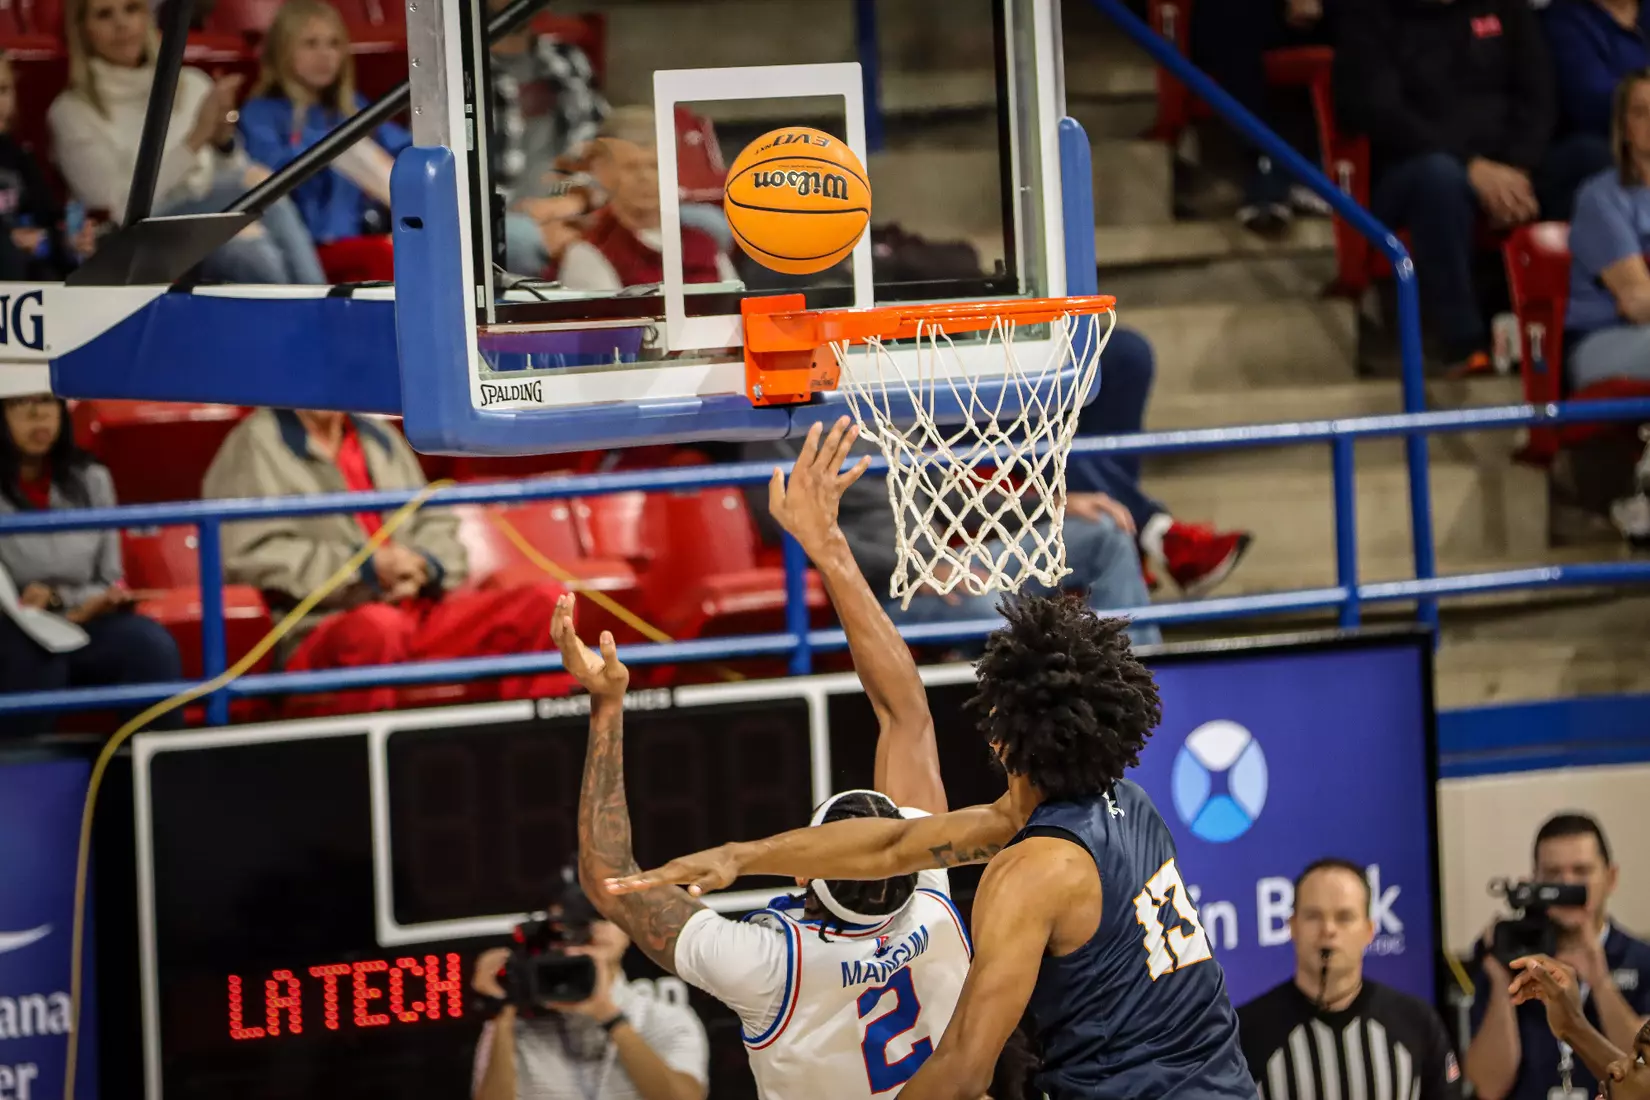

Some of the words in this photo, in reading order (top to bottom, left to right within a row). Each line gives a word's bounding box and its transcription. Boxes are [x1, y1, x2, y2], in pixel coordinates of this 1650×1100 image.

[753, 169, 849, 201] Wilson
[480, 379, 543, 407] SPALDING
[536, 687, 672, 719] DAKTNICS
[1132, 857, 1213, 982] 13
[1256, 863, 1405, 948] Bk
[308, 952, 463, 1031] TECH
[840, 924, 930, 989] MANGUM
[856, 964, 935, 1095] 2
